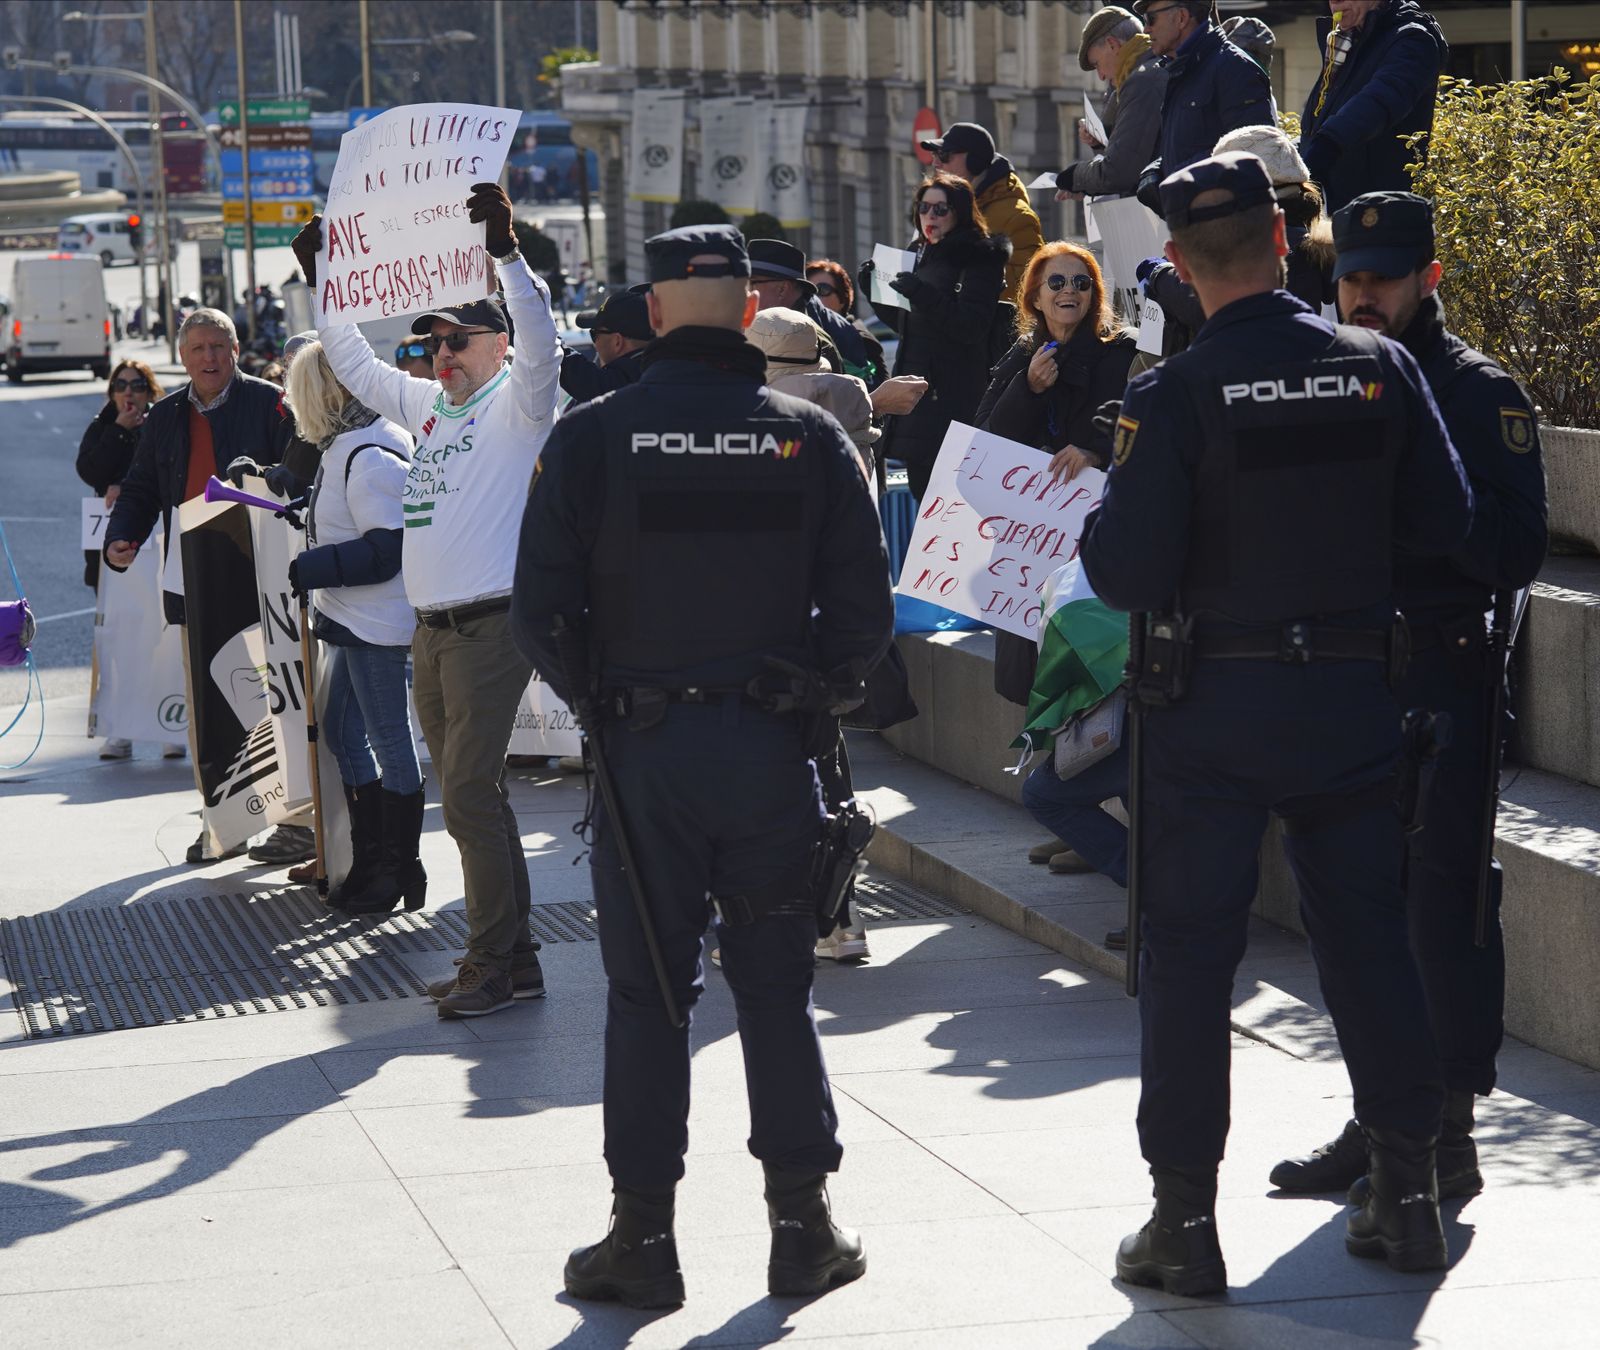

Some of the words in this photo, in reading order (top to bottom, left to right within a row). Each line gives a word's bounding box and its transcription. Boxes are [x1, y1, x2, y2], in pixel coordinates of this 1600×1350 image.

[410, 111, 507, 150] ULTIMOS
[365, 167, 389, 193] NO
[402, 156, 484, 185] TONTOS
[328, 212, 371, 262] AVE
[380, 217, 404, 234] DEL
[322, 244, 484, 315] ALGECIRAS-MADRID
[382, 293, 435, 316] CEUTA
[1222, 375, 1366, 406] POLICIA
[631, 432, 782, 455] POLICIA
[952, 446, 989, 481] EL
[921, 496, 966, 523] DE
[921, 535, 963, 562] ES
[912, 568, 960, 597] NO
